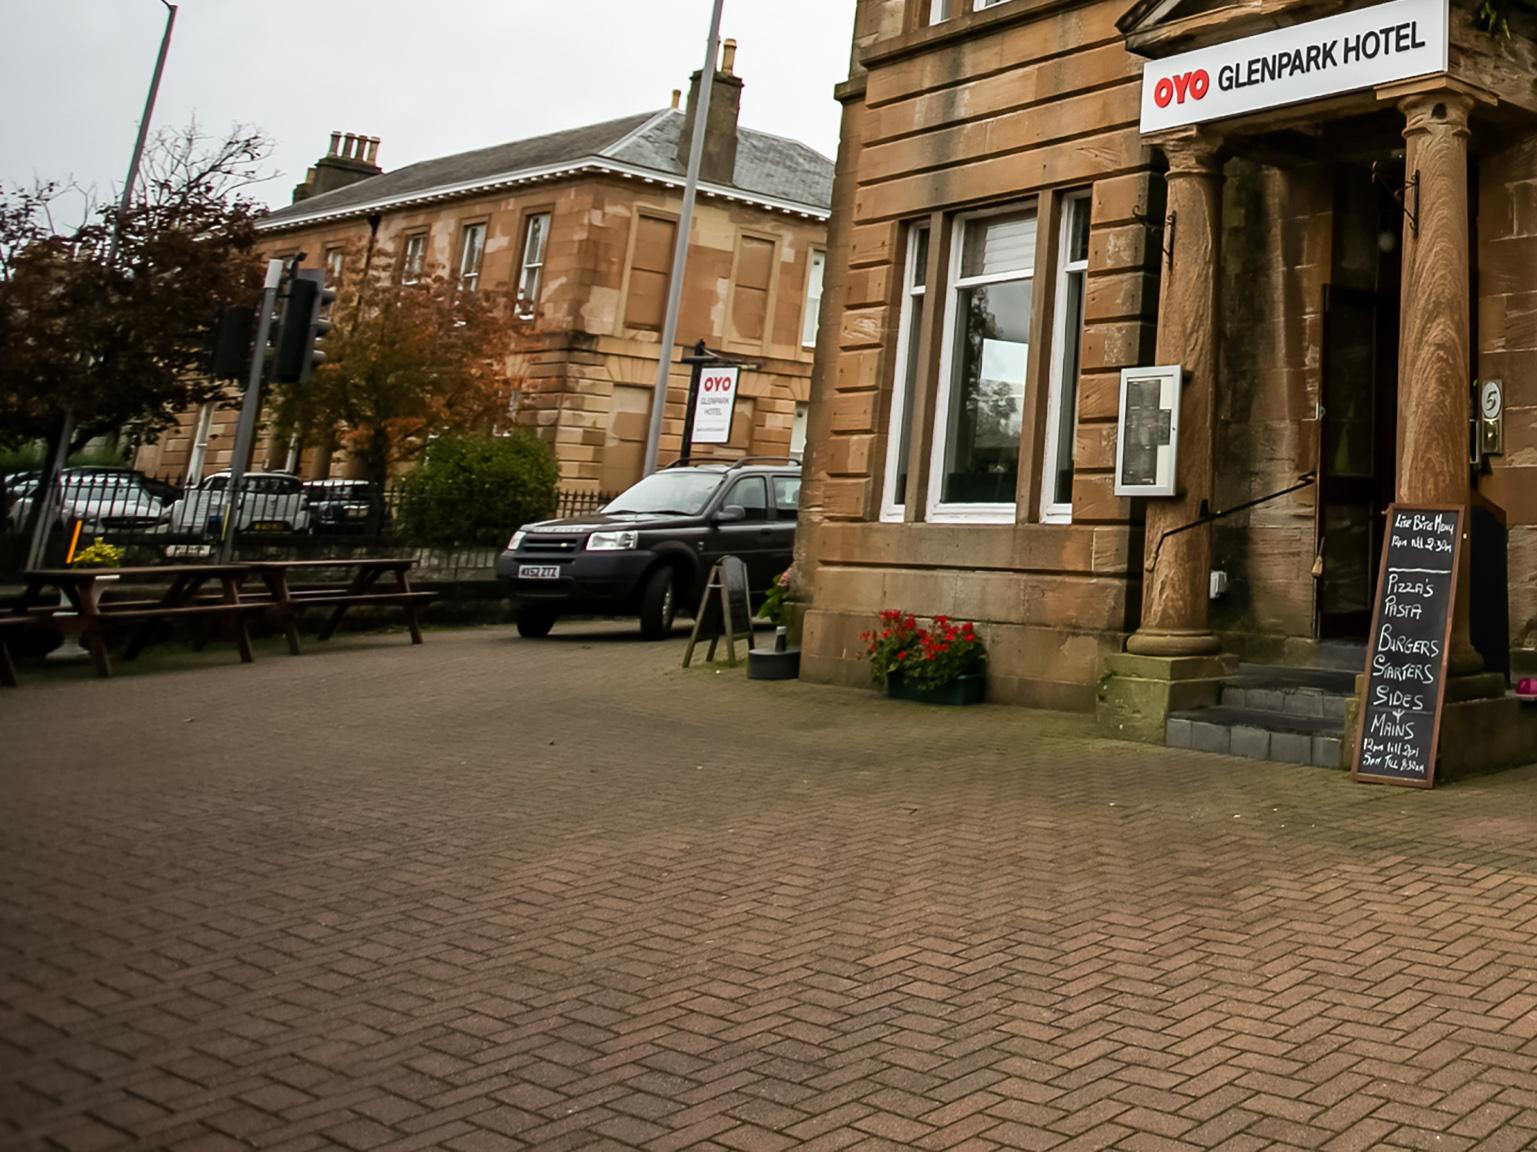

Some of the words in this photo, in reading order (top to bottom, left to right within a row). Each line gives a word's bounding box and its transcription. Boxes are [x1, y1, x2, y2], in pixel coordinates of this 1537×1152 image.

[1154, 69, 1210, 108] OYO
[1218, 40, 1338, 91] GLENPARK
[1343, 21, 1425, 64] HOTEL
[704, 377, 731, 392] OYO
[1486, 390, 1497, 411] 5
[1384, 595, 1422, 619] PASTA
[1378, 623, 1439, 657] BURGERS
[1372, 654, 1434, 684] STARTERS
[1373, 685, 1424, 709] SIDES
[1370, 713, 1415, 740] MAINS
